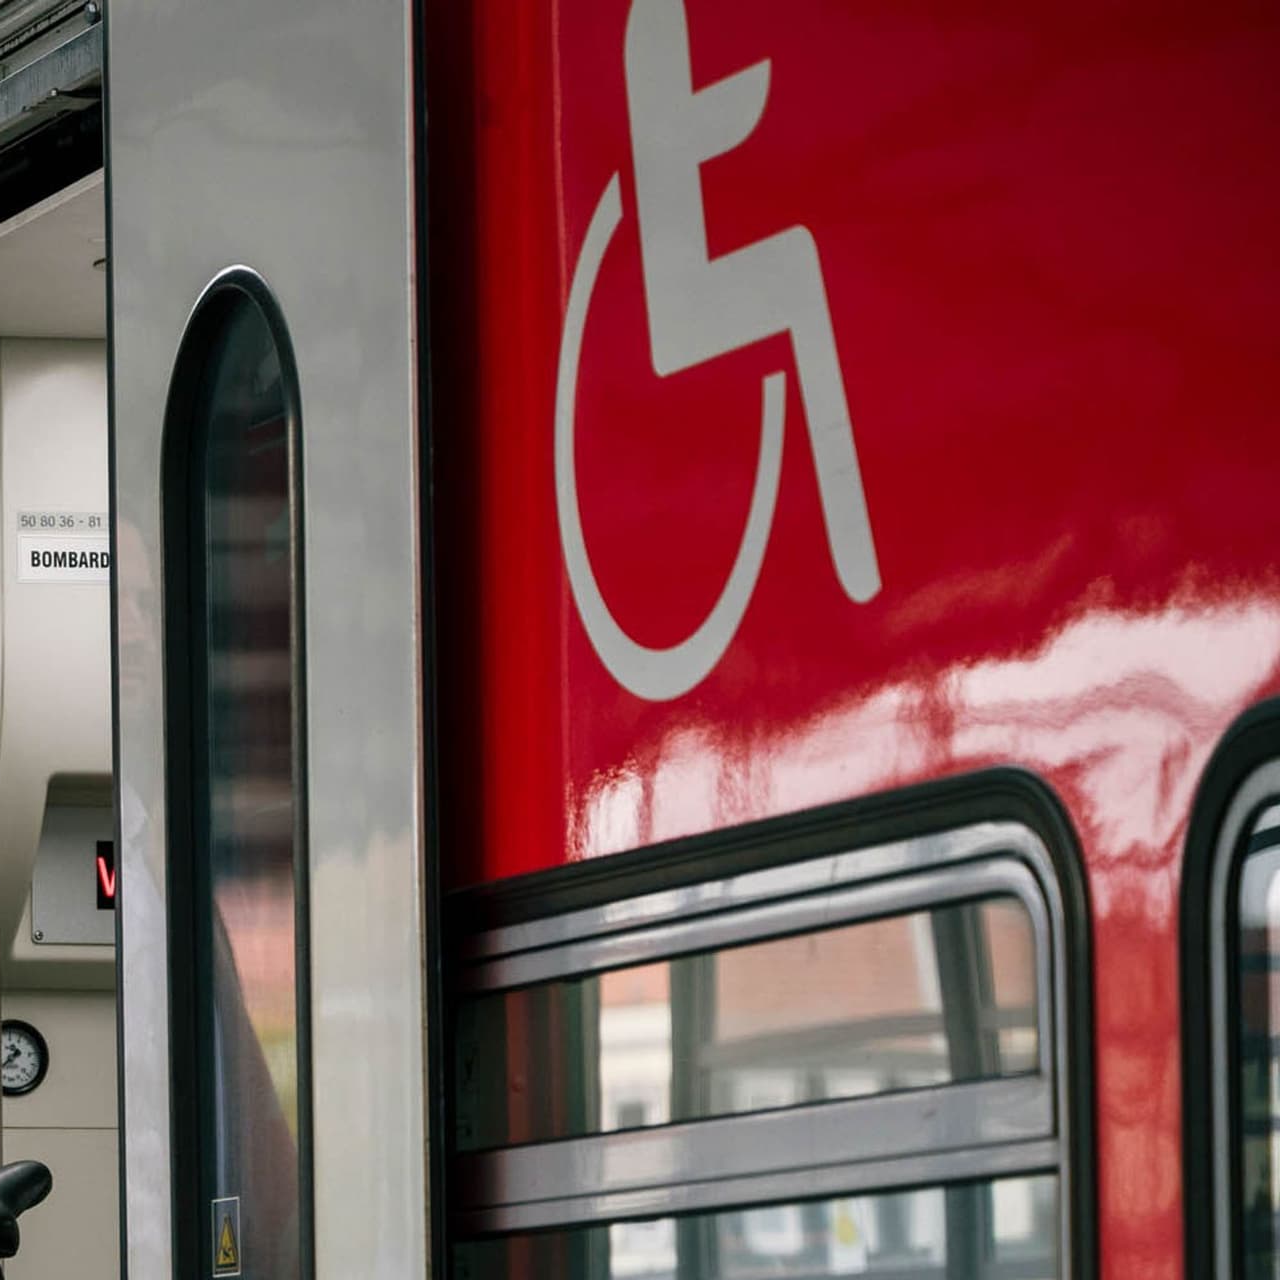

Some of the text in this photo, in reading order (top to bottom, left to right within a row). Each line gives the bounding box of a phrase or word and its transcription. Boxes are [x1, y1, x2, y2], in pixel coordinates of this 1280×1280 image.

[21, 515, 37, 528] 50
[40, 515, 56, 528] 80
[59, 516, 75, 528] 36
[88, 516, 102, 528] 81
[31, 551, 110, 569] BOMBARD
